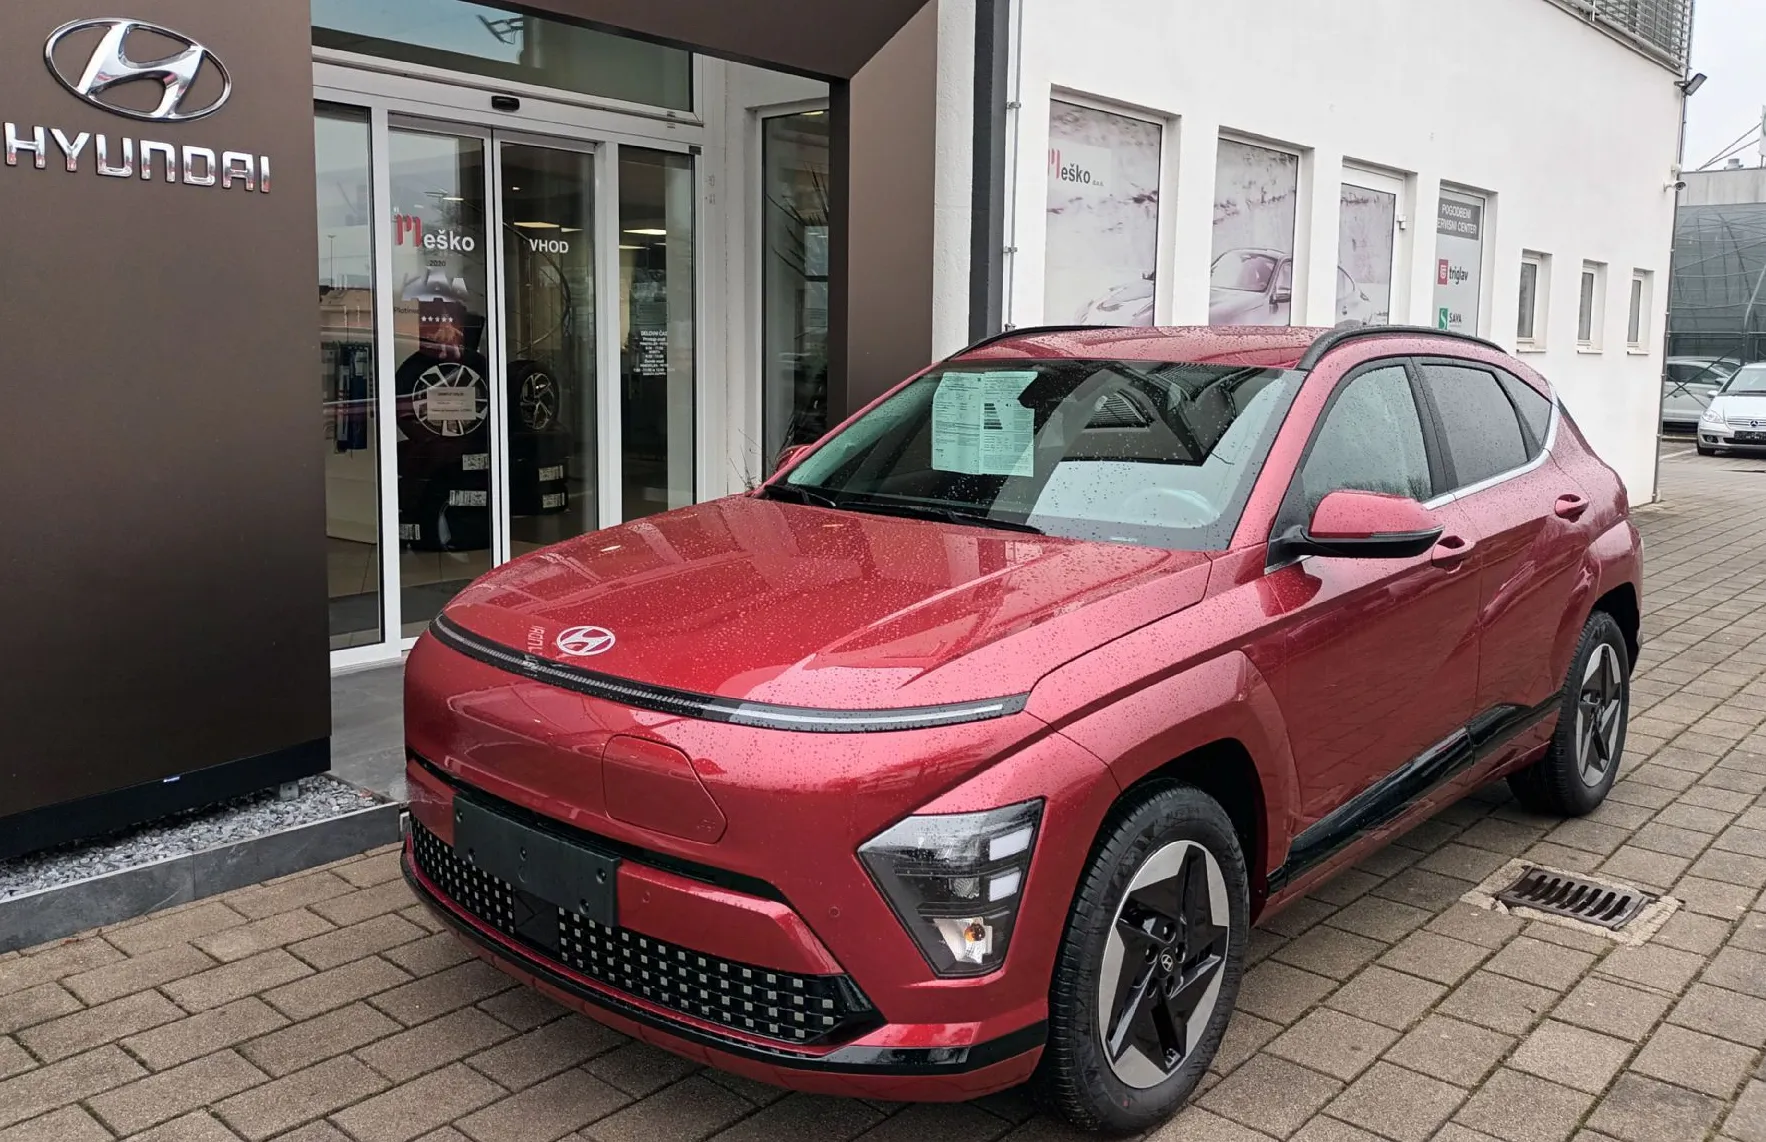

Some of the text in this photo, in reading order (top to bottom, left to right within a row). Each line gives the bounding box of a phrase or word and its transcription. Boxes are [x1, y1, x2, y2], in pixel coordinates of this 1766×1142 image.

[3, 122, 271, 193] HYUNDAI
[395, 213, 475, 251] Meško
[1436, 217, 1477, 235] ERVISNI CENTER
[529, 239, 569, 253] VHOD
[1449, 266, 1469, 285] triglav
